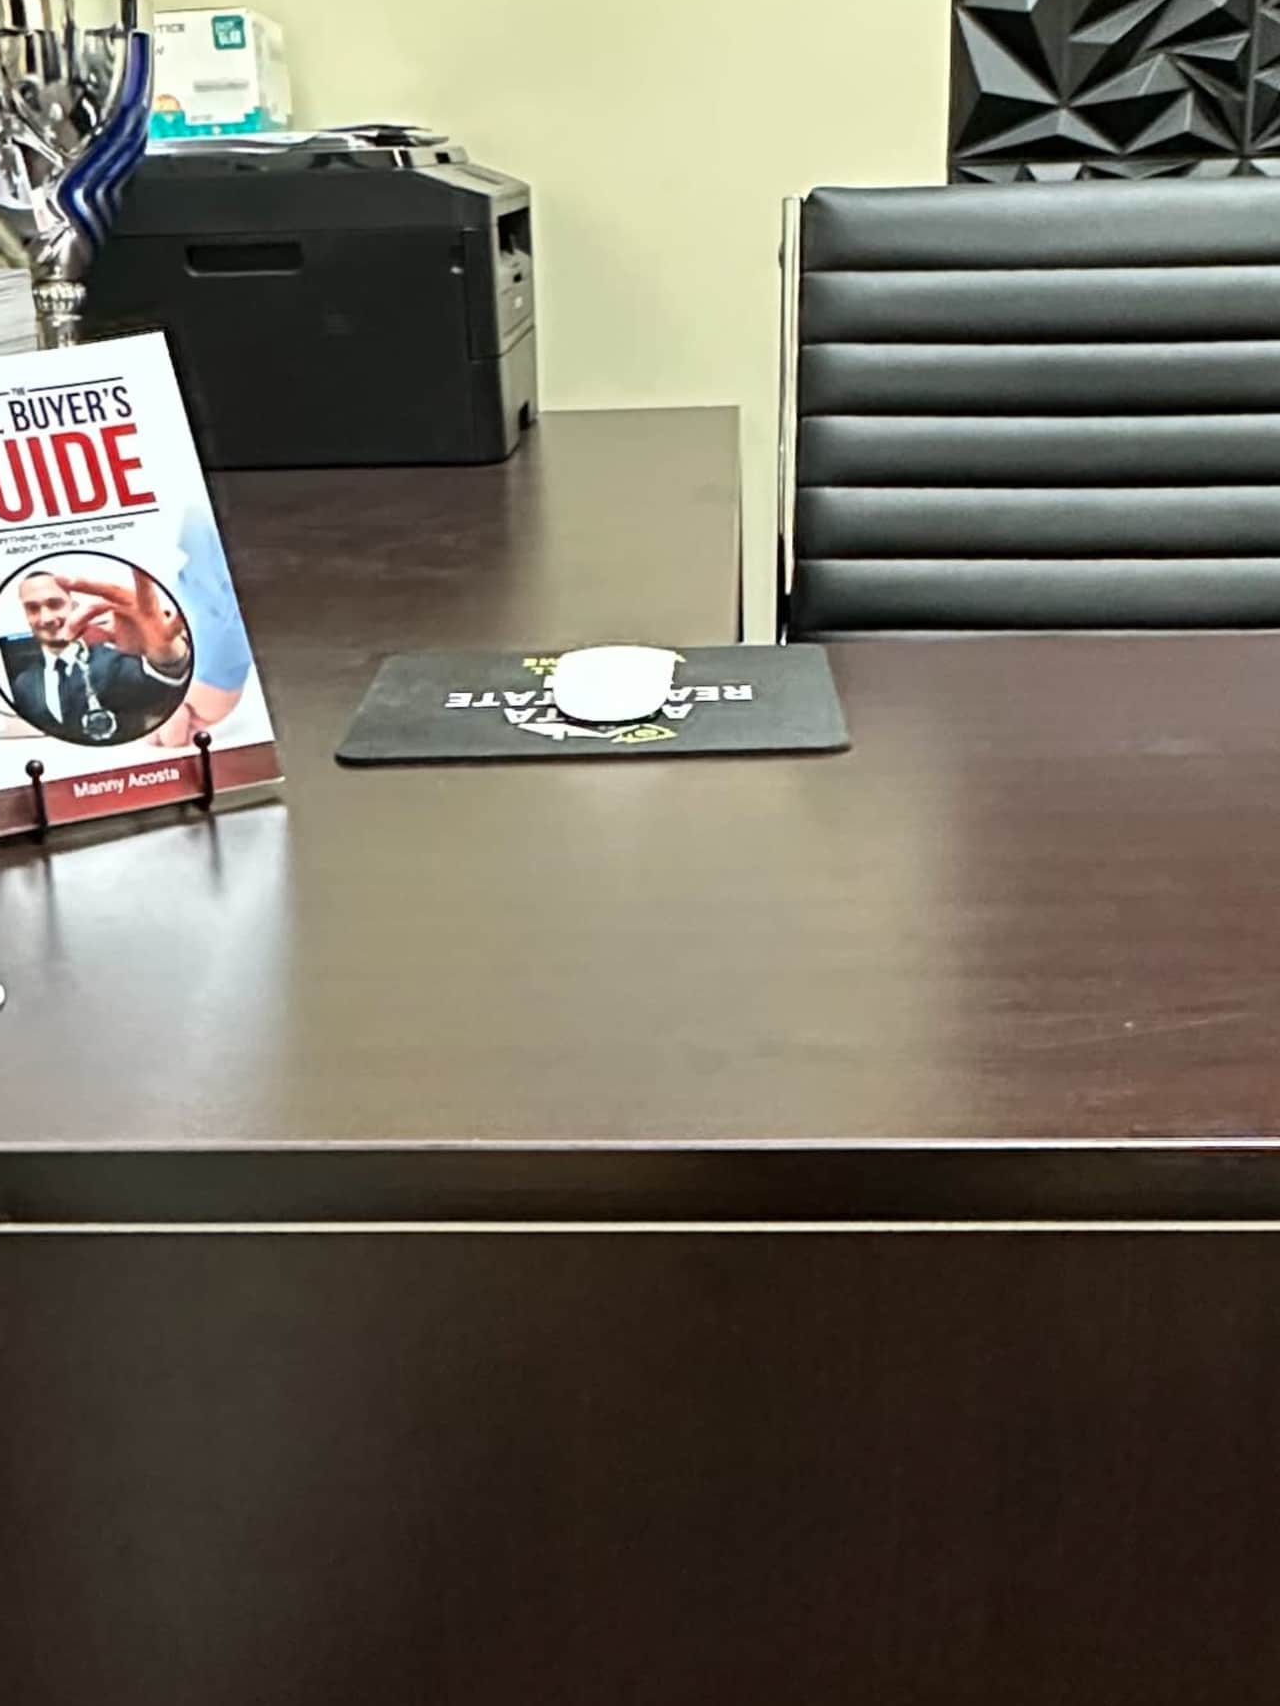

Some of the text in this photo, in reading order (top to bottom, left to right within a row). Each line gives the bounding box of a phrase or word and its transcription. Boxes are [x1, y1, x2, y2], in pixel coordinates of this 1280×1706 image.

[8, 385, 133, 432] BUYER'S
[444, 684, 753, 708] REA TATE
[73, 767, 180, 798] Manny Acosta
